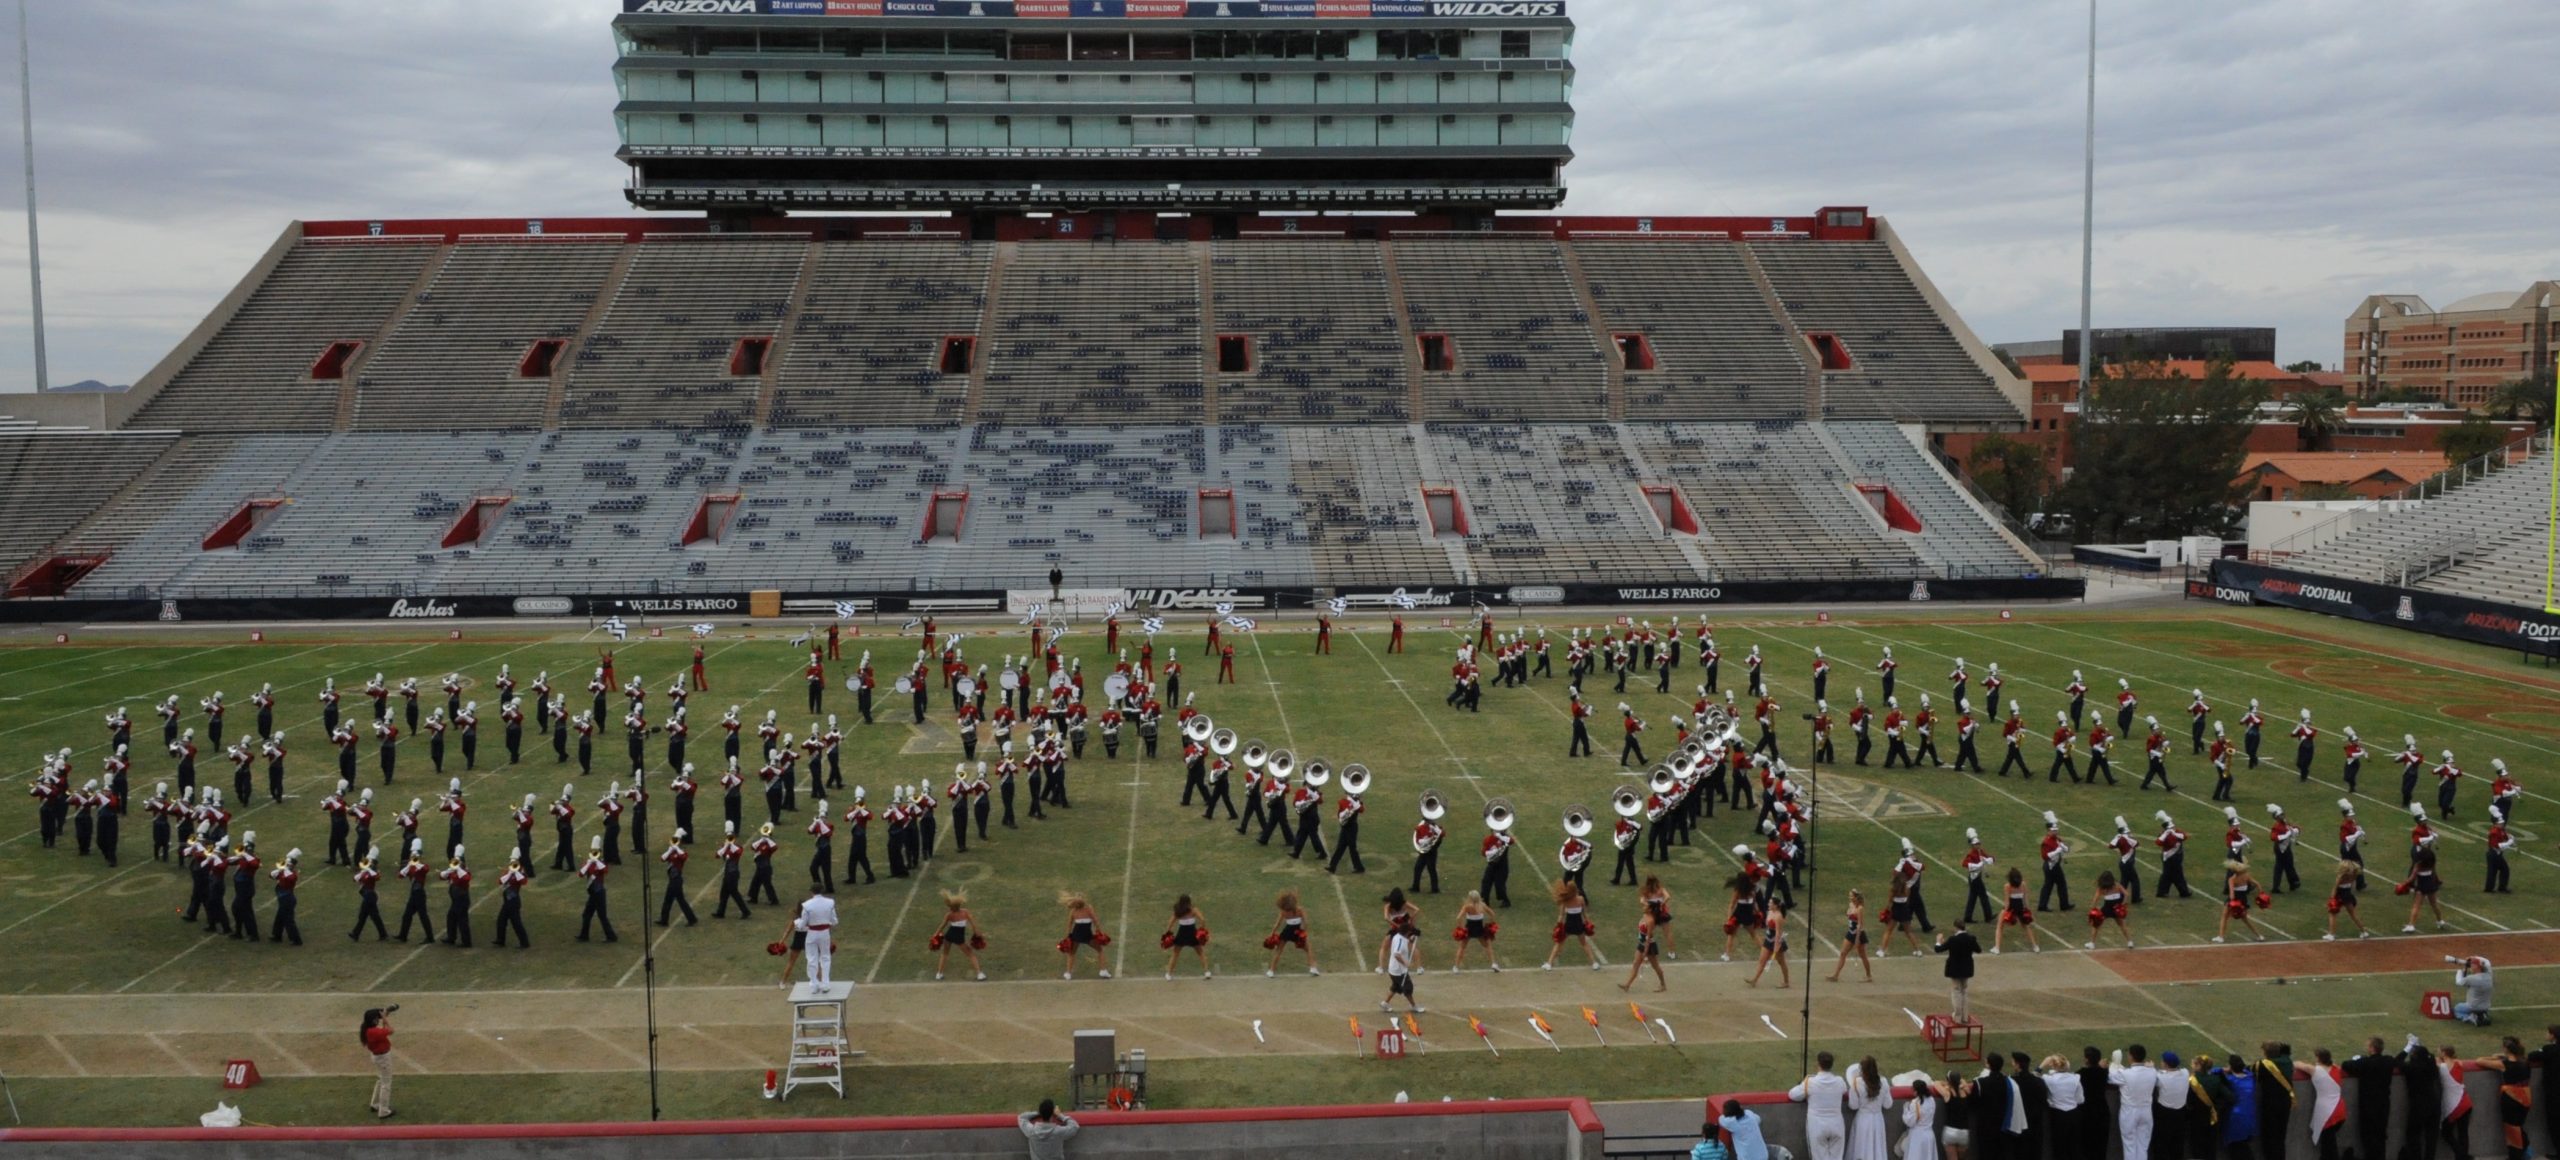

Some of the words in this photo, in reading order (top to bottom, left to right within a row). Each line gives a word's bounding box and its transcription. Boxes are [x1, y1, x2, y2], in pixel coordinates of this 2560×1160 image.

[636, 0, 757, 12] ARIZONA
[772, 1, 781, 9] 22
[893, 3, 916, 11] CHUCK
[1432, 3, 1559, 16] WILDCATS
[370, 227, 382, 236] 17
[529, 225, 541, 235] 18
[909, 223, 923, 233] 20
[1060, 223, 1072, 232] 21
[1284, 222, 1297, 232] 22
[1638, 223, 1651, 232] 24
[1772, 223, 1786, 232] 25
[1617, 588, 1669, 600] WELLS
[1671, 587, 1721, 600] FARGO
[388, 598, 458, 618] Bashas'
[628, 599, 684, 611] WELLS
[685, 598, 738, 610] FARGO
[2430, 996, 2450, 1015] 20
[1381, 1033, 1399, 1054] 40
[226, 1063, 247, 1085] 40
